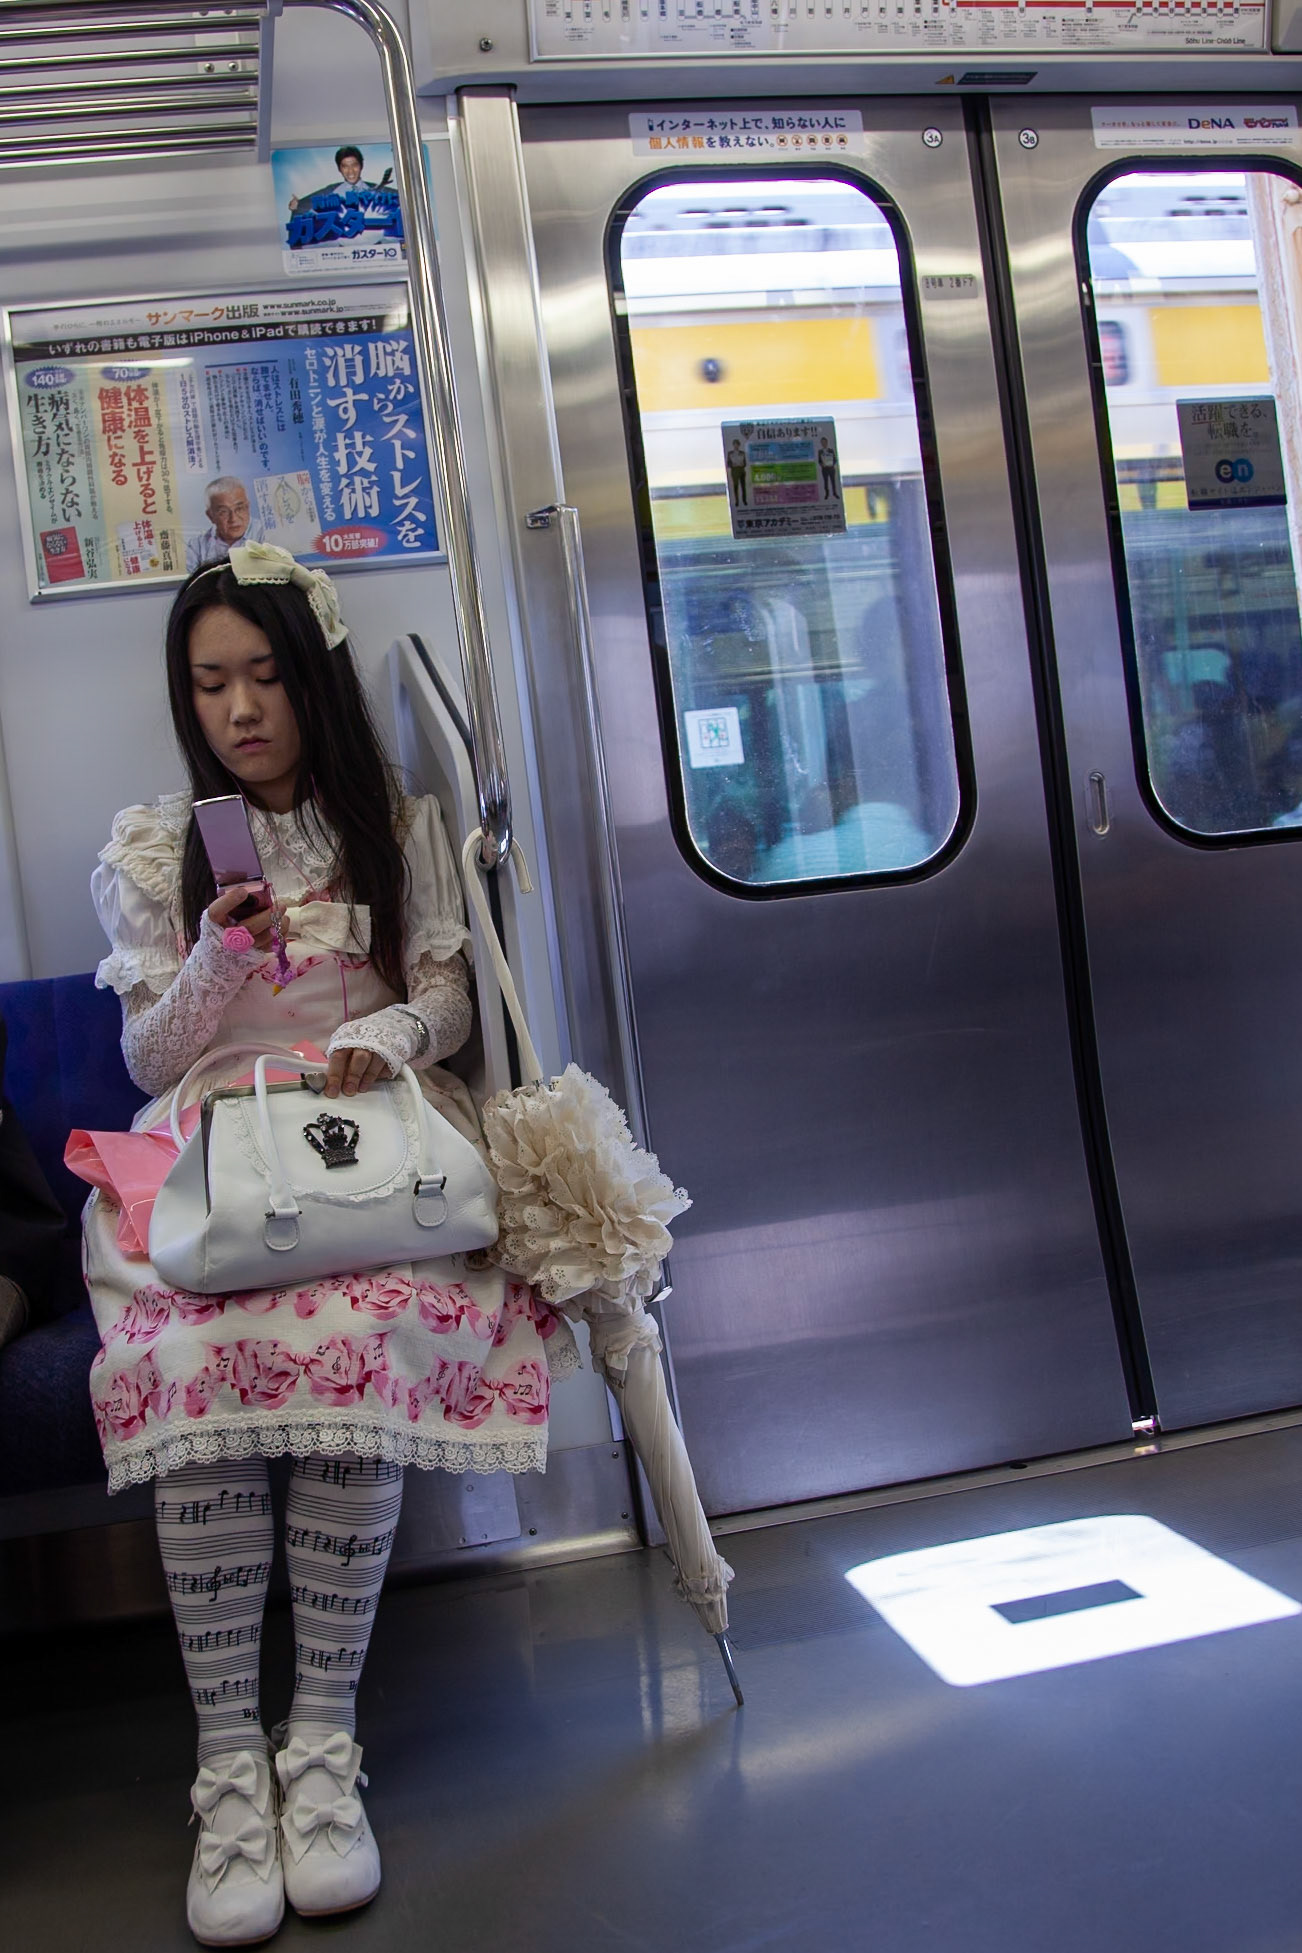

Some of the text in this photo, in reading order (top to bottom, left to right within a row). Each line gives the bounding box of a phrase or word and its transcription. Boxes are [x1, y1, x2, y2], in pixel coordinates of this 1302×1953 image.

[649, 134, 775, 150] 個人情報を教えない。
[656, 116, 846, 132] インターネット上で、知らない人に
[1187, 117, 1236, 130] DeNA
[351, 247, 398, 260] ガスター10
[146, 303, 260, 326] サンマーク出版
[262, 298, 337, 310] www.sunmark.co.jp
[27, 393, 51, 457] 生き方
[271, 365, 286, 432] 人はストレスには
[48, 390, 82, 523] 病気にならない
[98, 386, 129, 486] 健康になる
[124, 384, 158, 515] 体温を上げると
[304, 346, 336, 521] セロトニンと涙が人生を変える
[322, 344, 381, 520] 消す技術
[368, 340, 427, 548] 脳からストレスを
